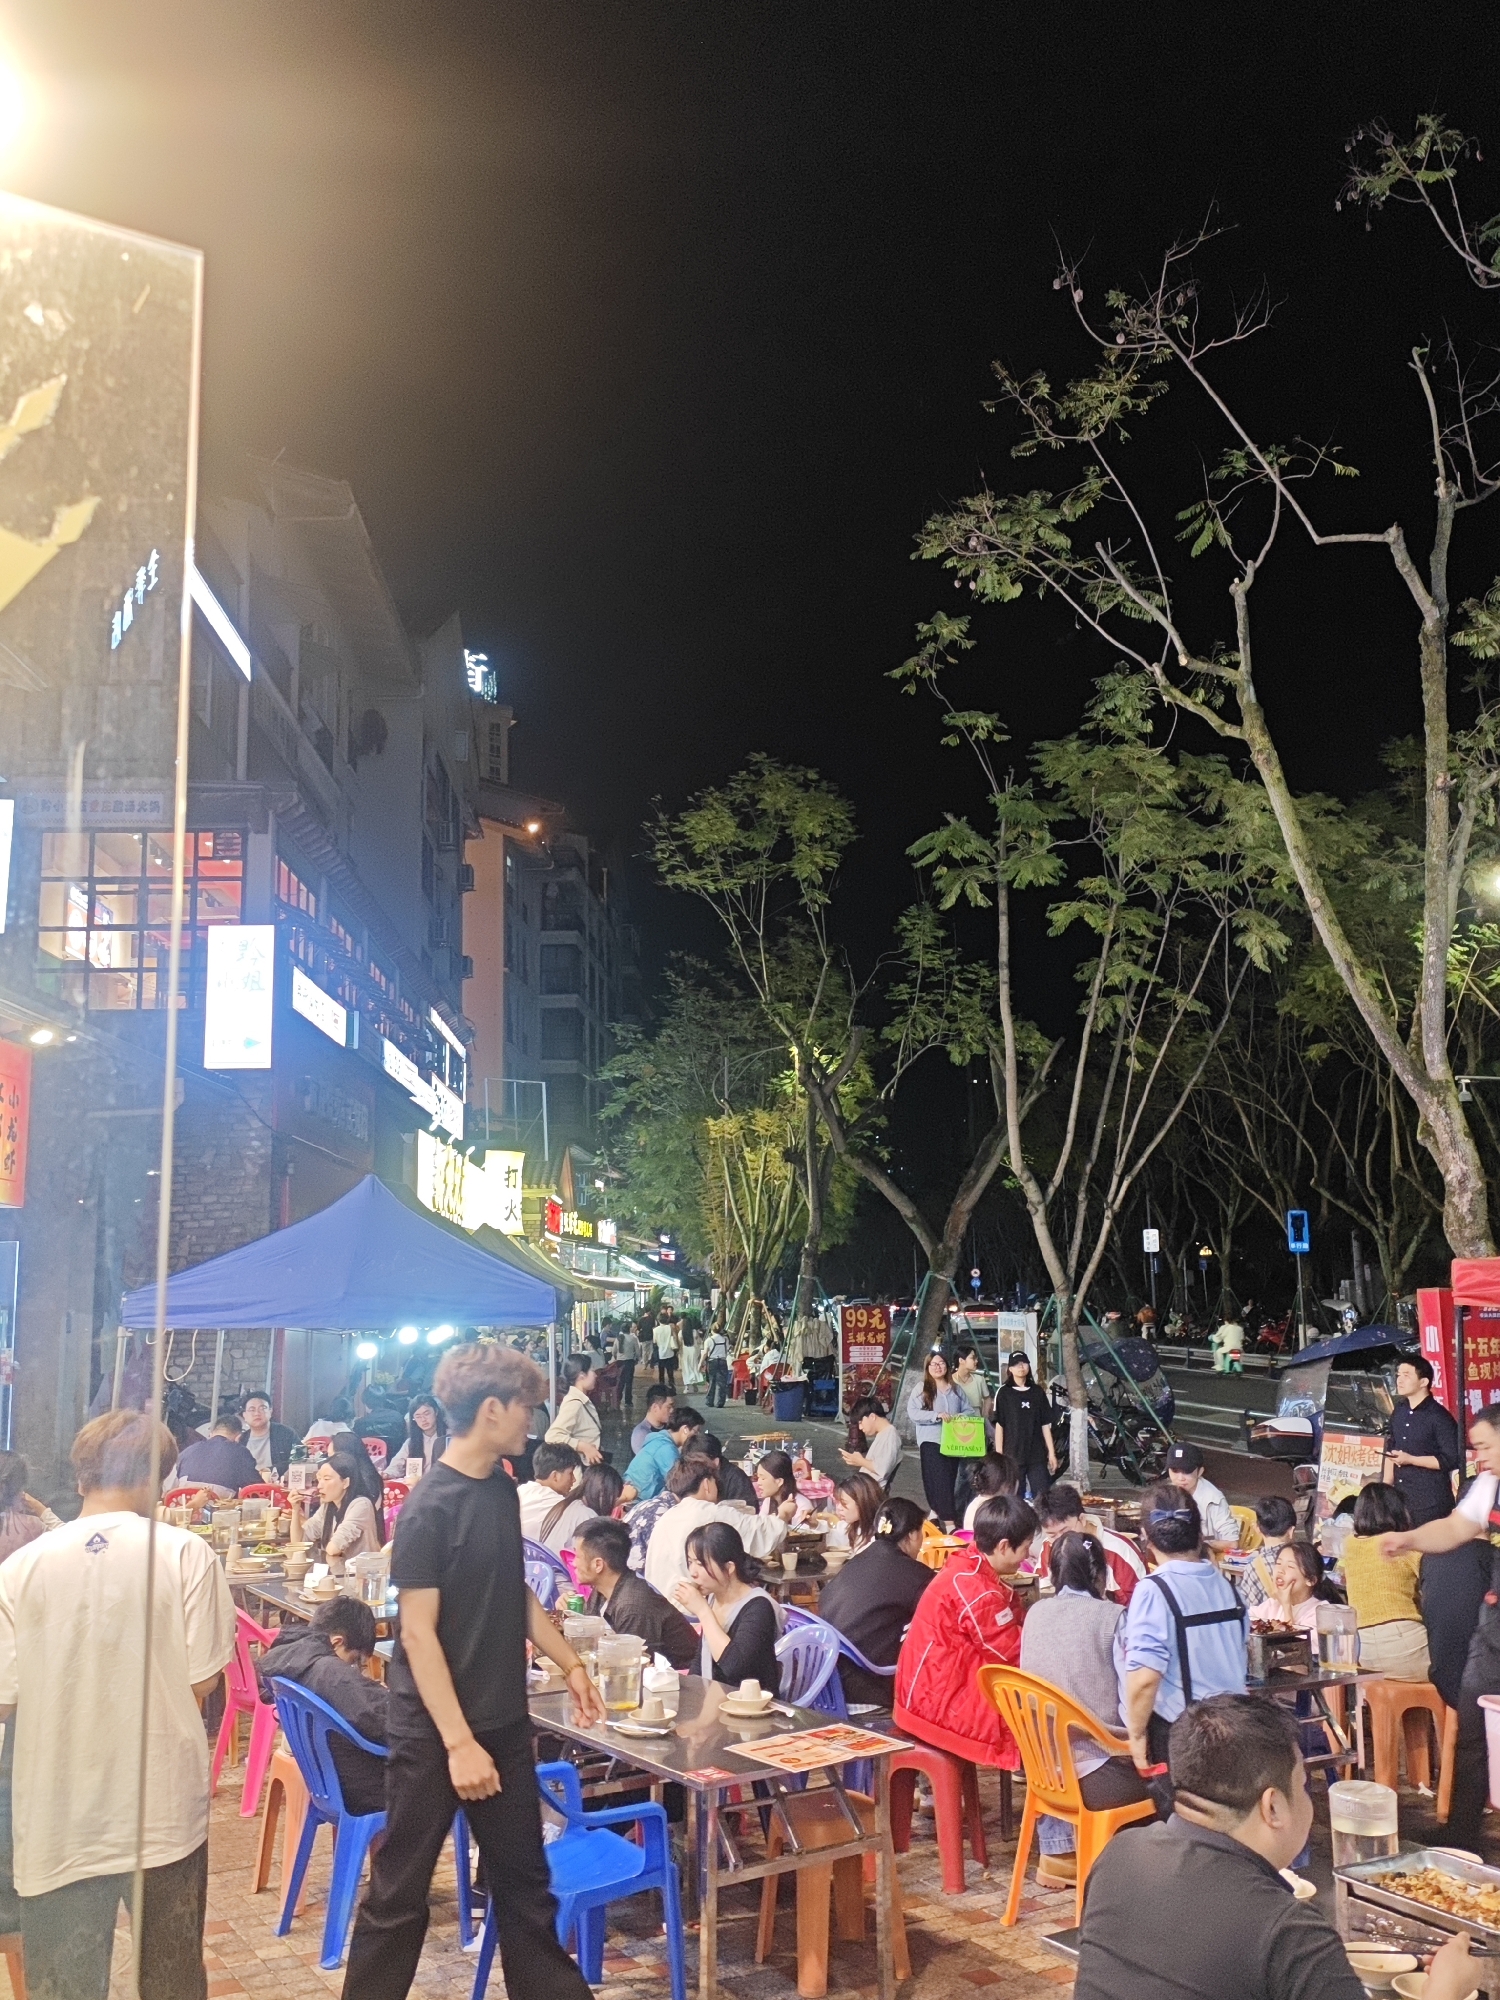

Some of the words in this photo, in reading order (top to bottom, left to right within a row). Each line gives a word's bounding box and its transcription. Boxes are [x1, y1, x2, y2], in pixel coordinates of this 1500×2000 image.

[3, 1084, 20, 1175] 小龙虾
[845, 1307, 887, 1330] 99元
[846, 1331, 887, 1345] 三拼龙虾
